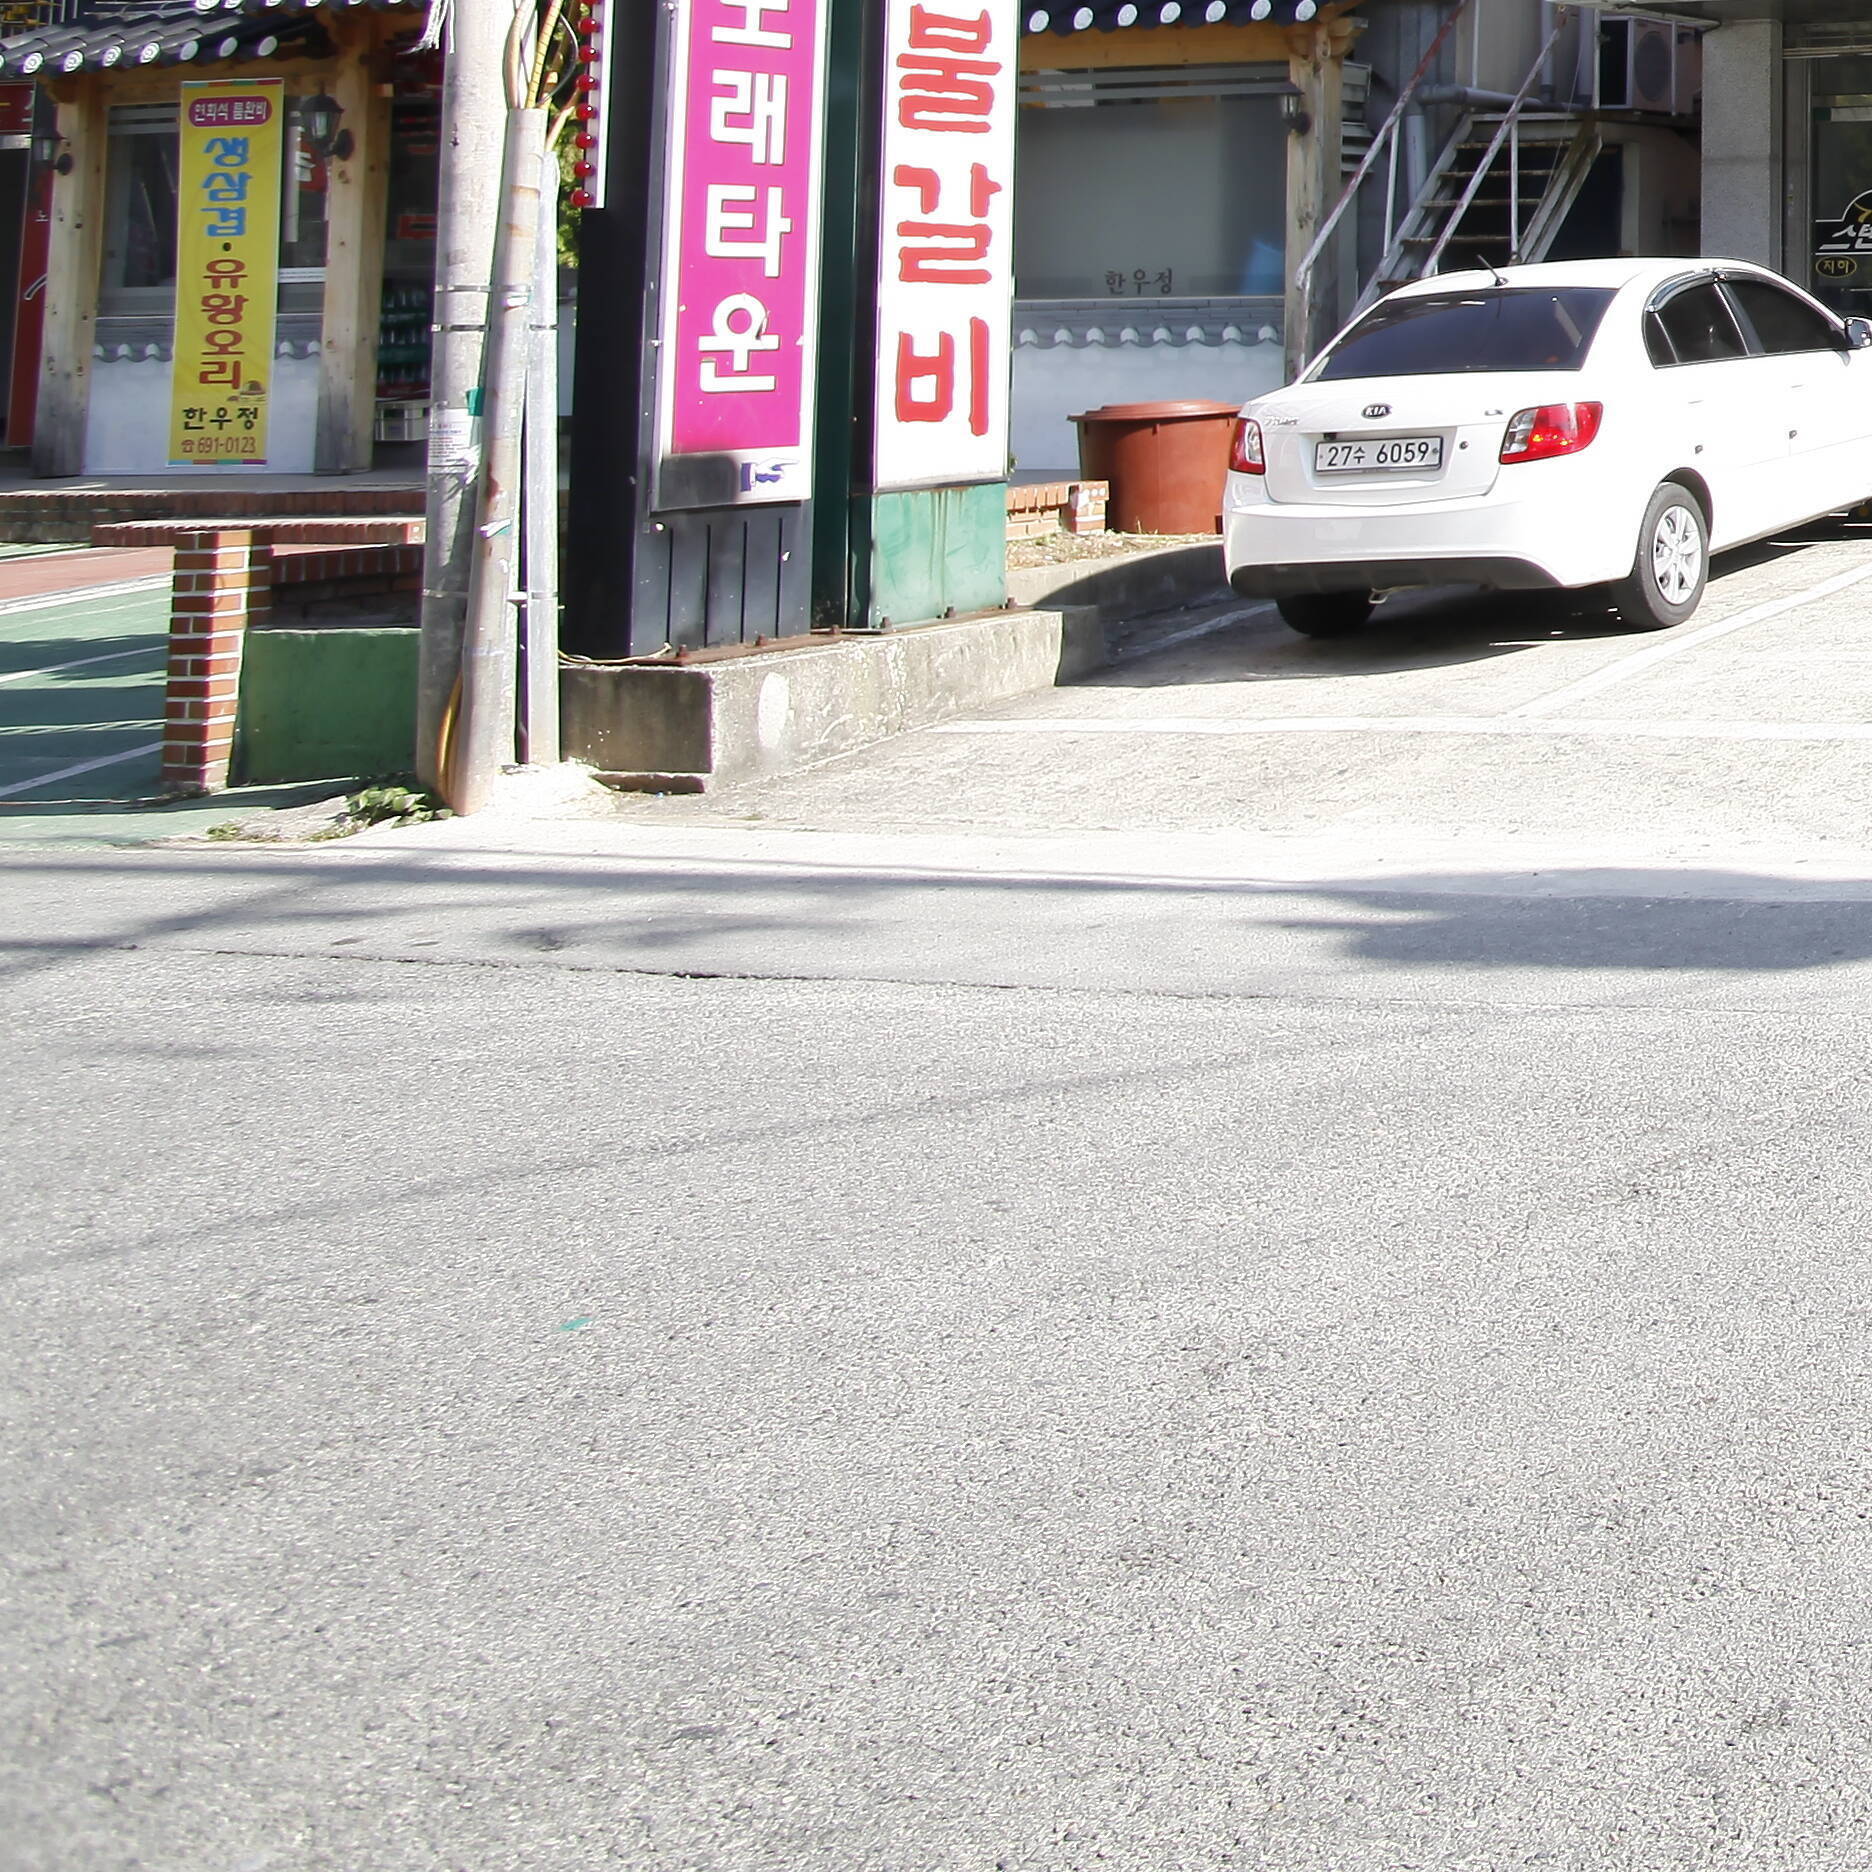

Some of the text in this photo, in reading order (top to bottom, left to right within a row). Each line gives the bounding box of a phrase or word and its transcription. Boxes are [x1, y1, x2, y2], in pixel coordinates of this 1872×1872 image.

[199, 136, 253, 390] 생삼겹 유황오리
[1104, 267, 1173, 296] 한우정
[183, 407, 259, 431] 한우정
[1366, 405, 1388, 418] KIA
[198, 436, 257, 454] 691-0123
[1327, 441, 1430, 467] 27수 6059
